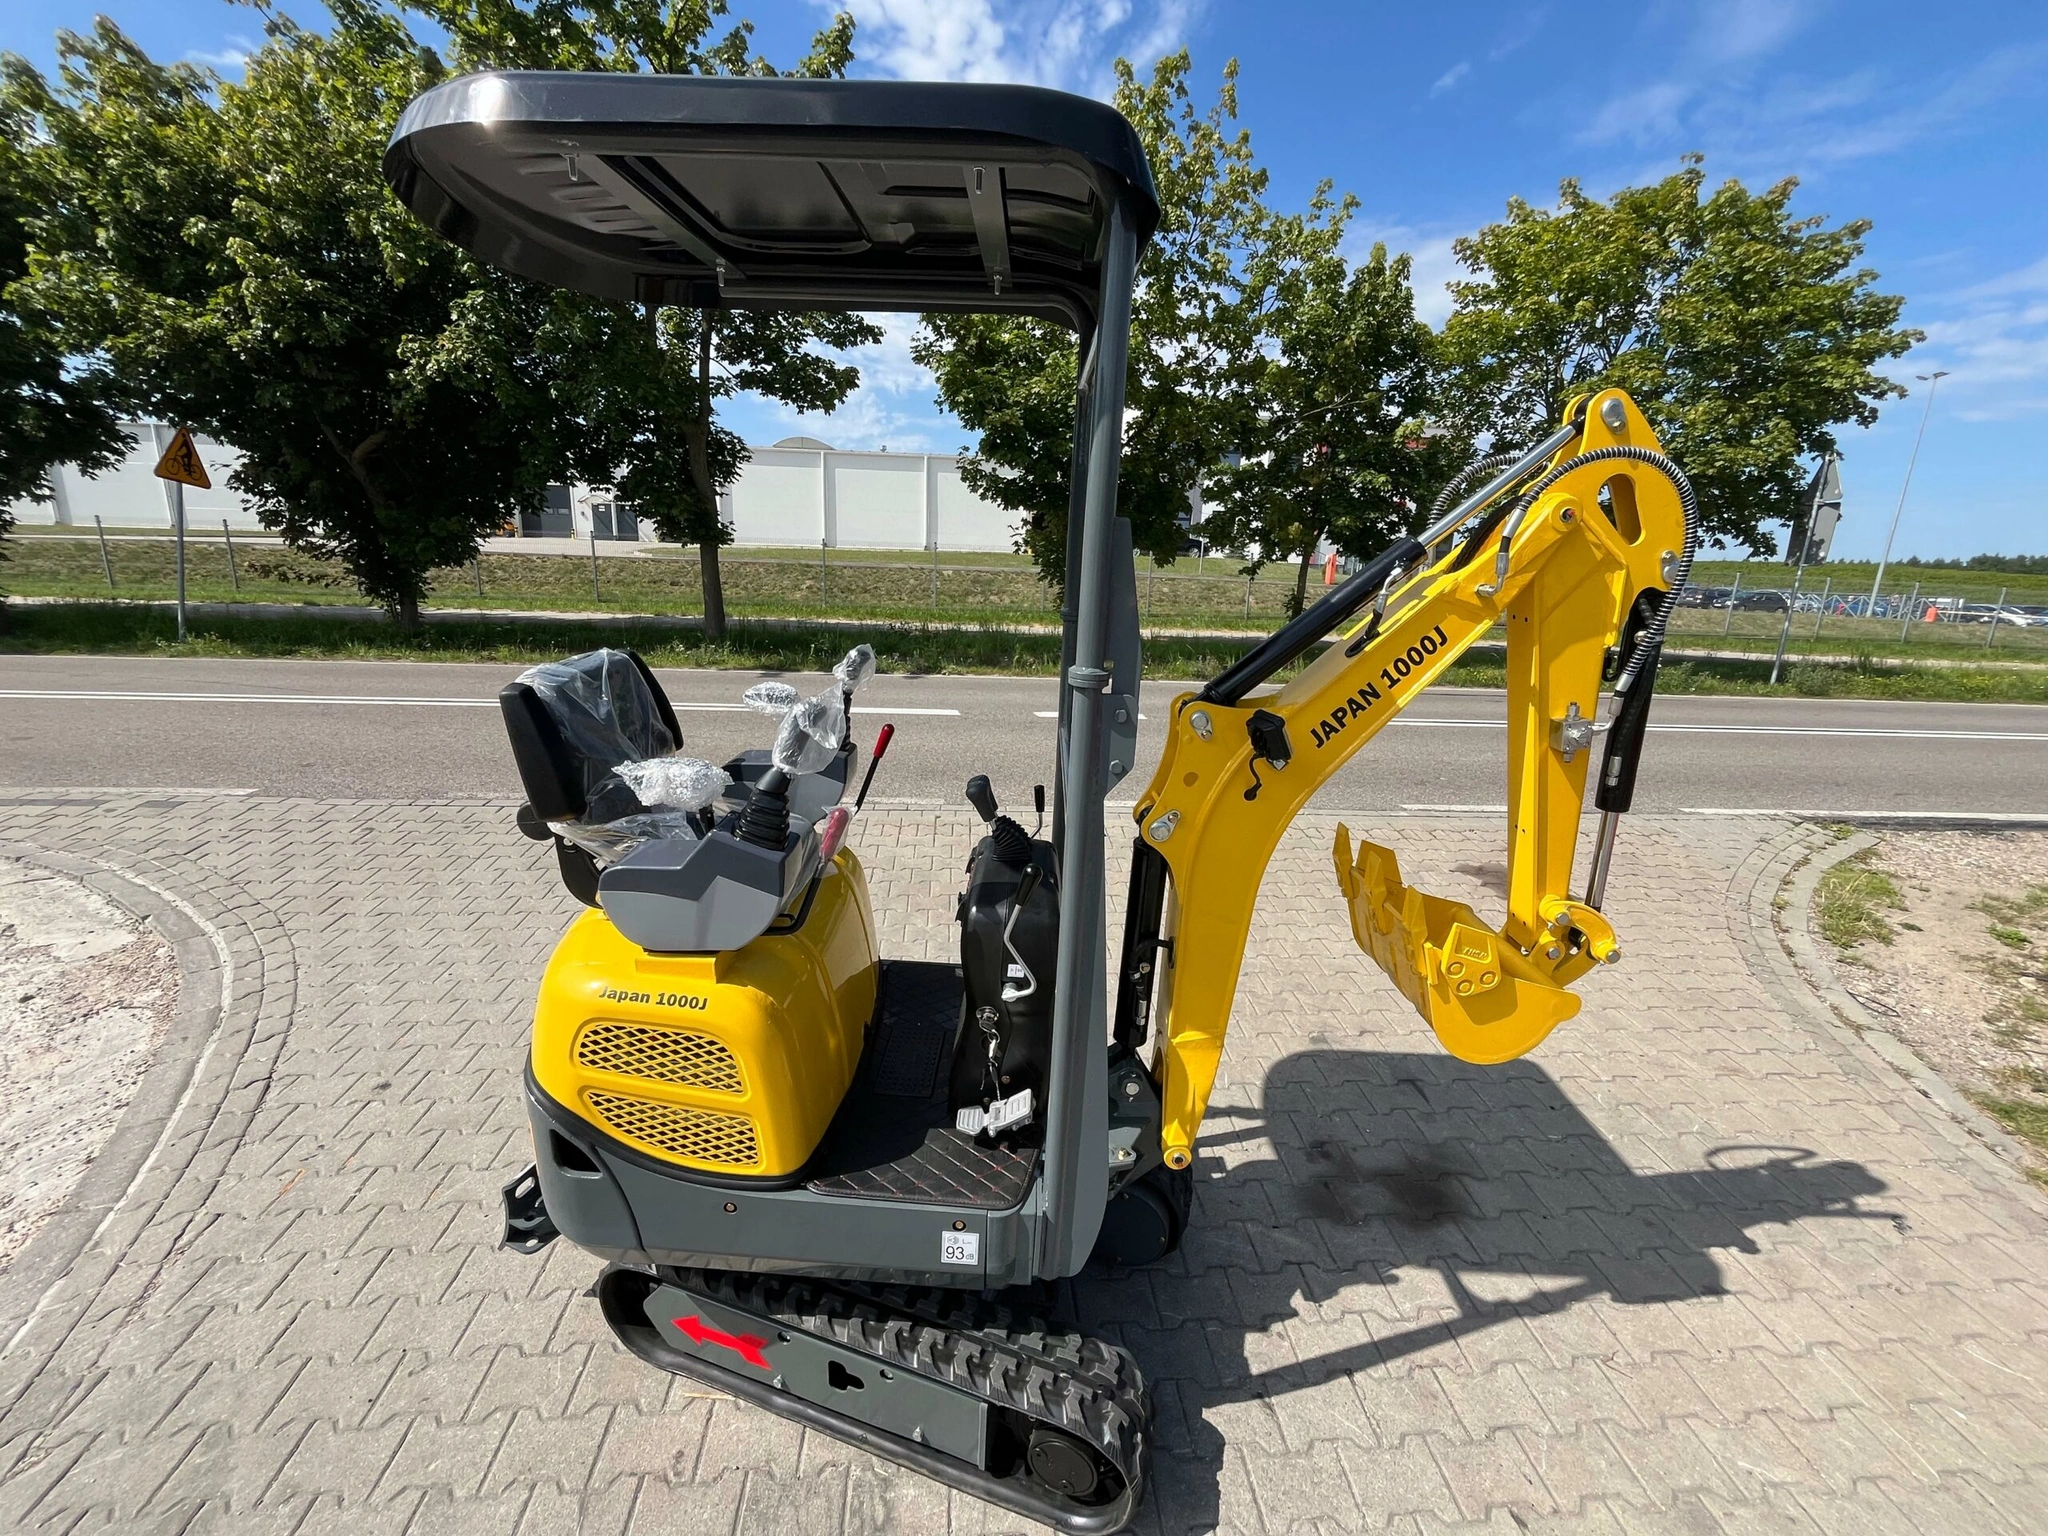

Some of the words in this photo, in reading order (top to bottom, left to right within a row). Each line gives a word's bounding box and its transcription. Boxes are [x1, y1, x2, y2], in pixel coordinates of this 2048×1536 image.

[1310, 682, 1381, 748] JAPAN
[1380, 625, 1448, 689] 1000J
[599, 986, 650, 1003] Japan
[655, 992, 708, 1010] 1000J
[945, 1245, 965, 1260] 93
